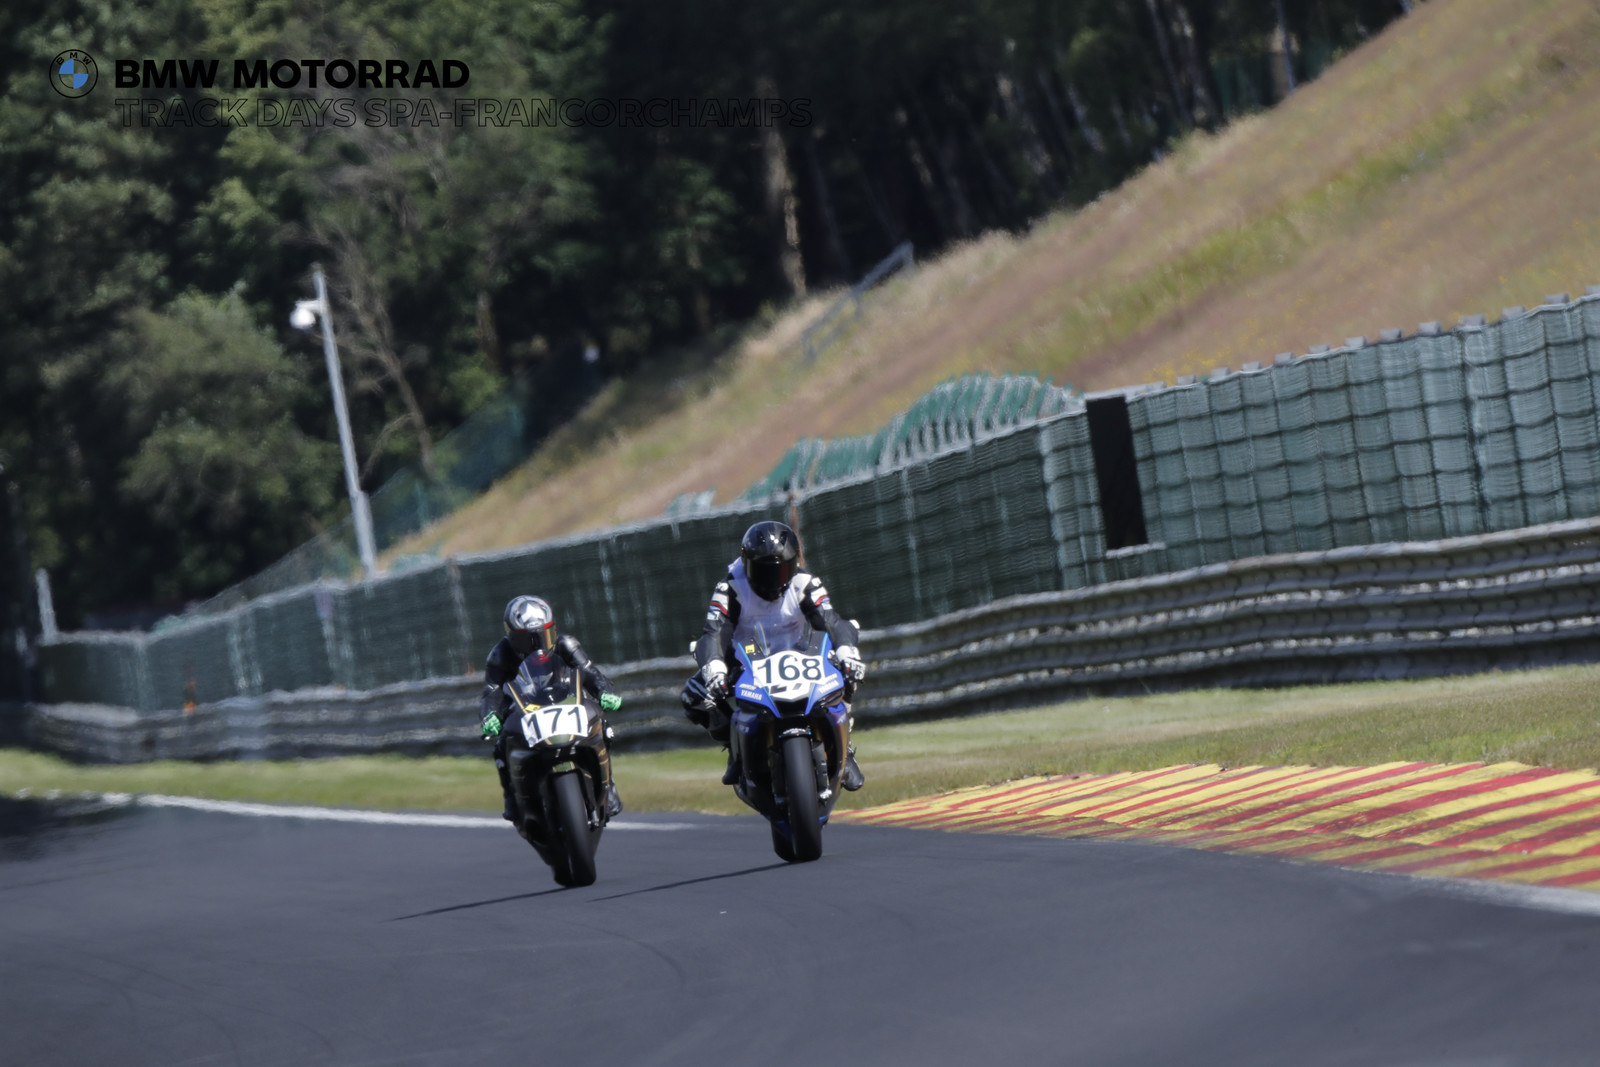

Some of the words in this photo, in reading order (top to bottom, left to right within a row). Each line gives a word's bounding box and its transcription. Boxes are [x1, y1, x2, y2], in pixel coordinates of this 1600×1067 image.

[757, 654, 822, 684] 168
[741, 689, 763, 701] YAMAHA
[526, 706, 582, 740] 171
